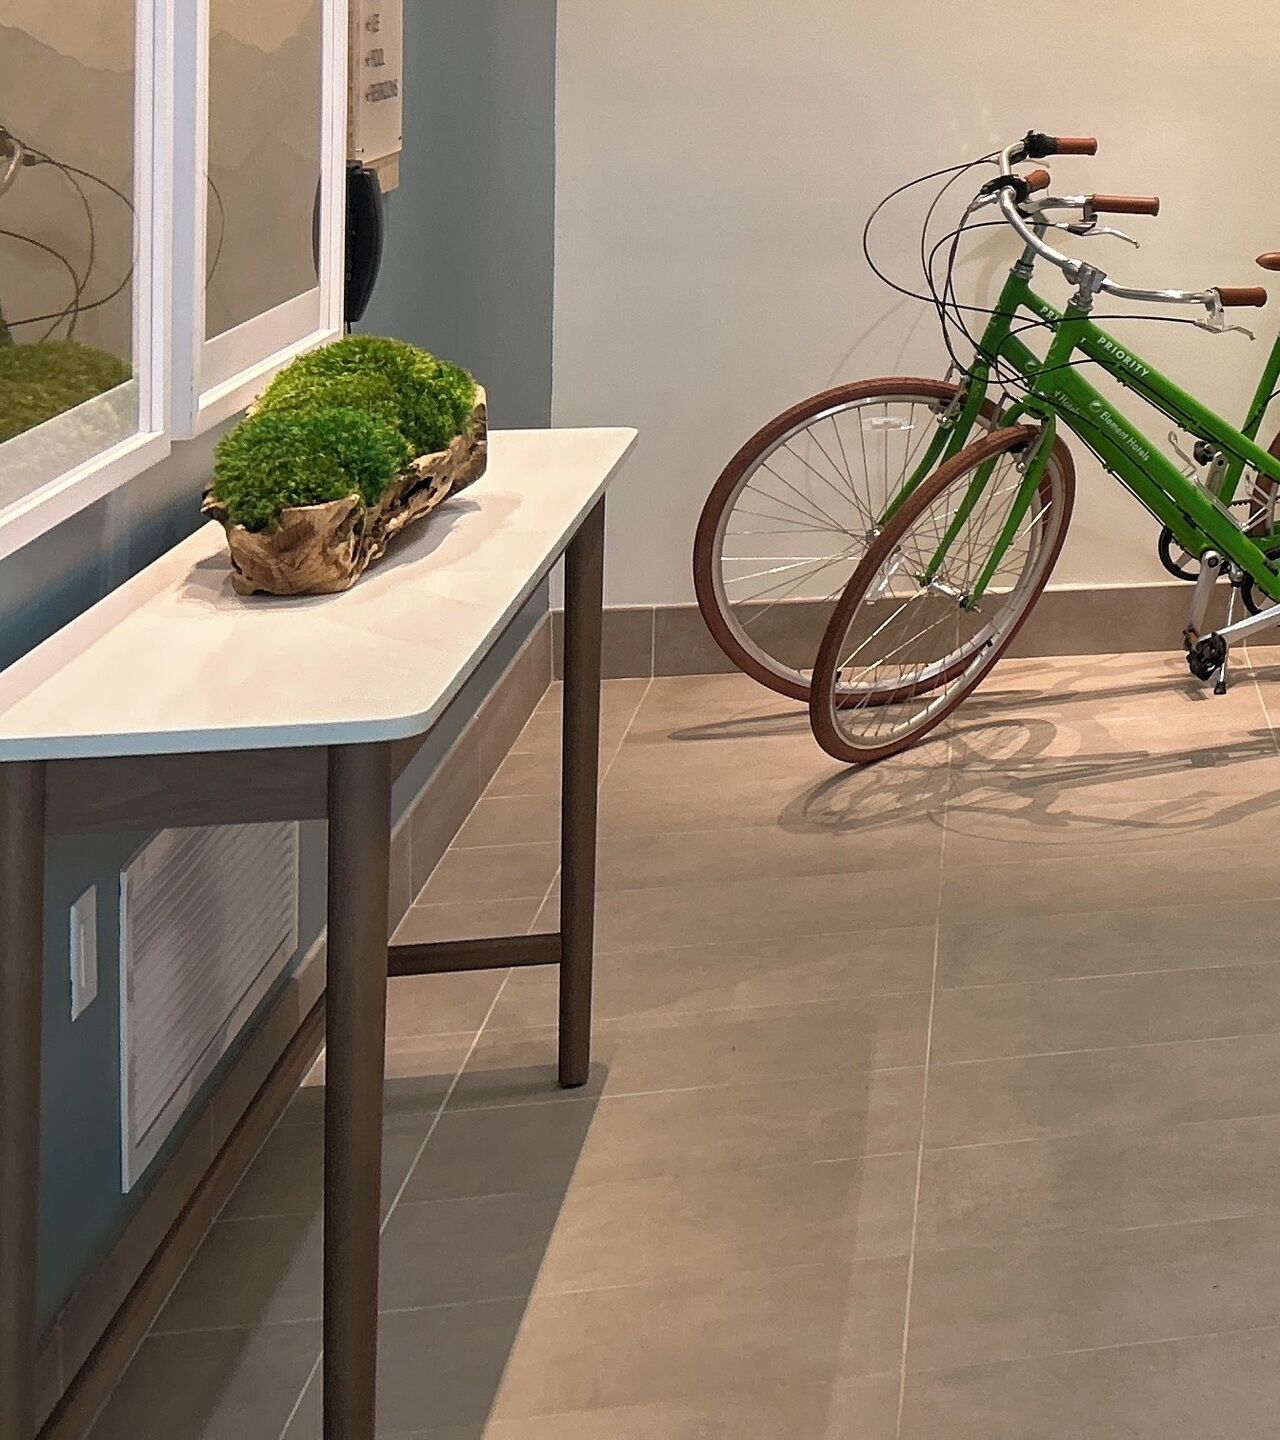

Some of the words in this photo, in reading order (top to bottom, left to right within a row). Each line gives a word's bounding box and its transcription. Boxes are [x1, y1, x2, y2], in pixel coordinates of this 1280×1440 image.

[1096, 336, 1150, 377] PRIORITY
[1099, 411, 1128, 440] Element
[1126, 436, 1150, 462] Hotels
